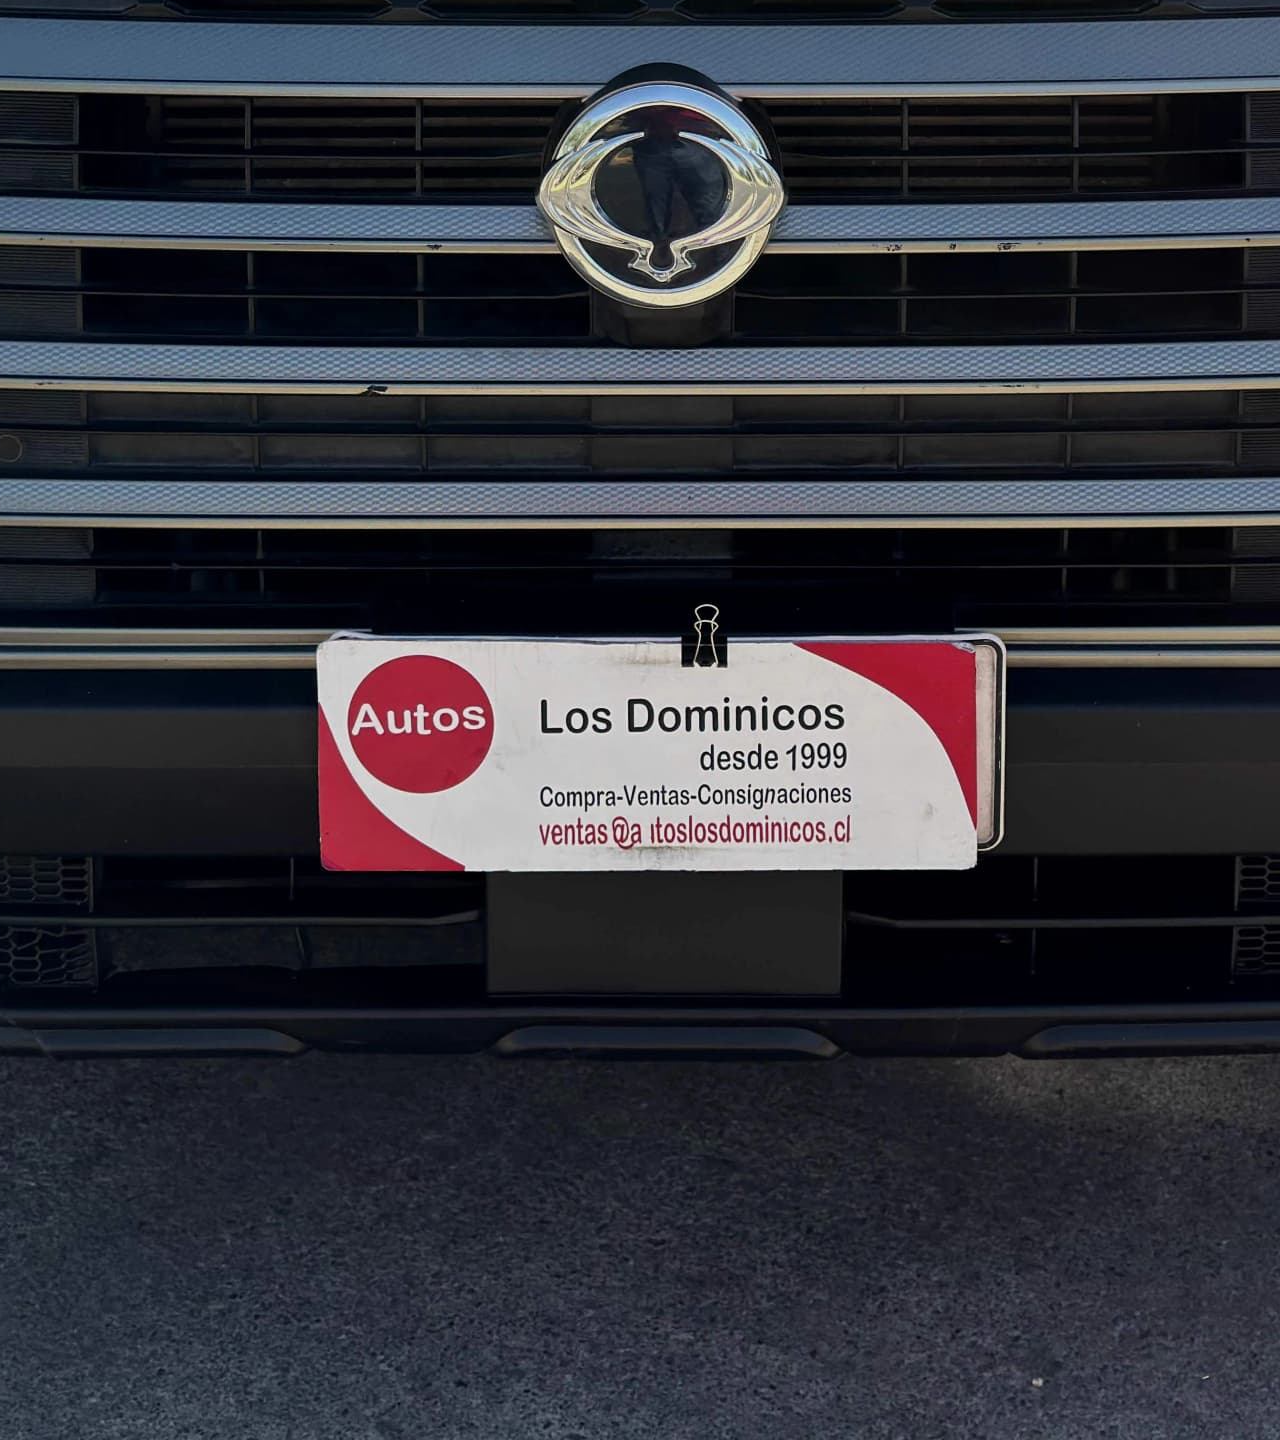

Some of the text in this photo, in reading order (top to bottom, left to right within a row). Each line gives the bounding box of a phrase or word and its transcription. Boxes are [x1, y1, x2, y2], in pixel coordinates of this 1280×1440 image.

[351, 702, 487, 736] Autos
[540, 696, 846, 735] Los Dominicos
[699, 741, 848, 771] desde 1999
[539, 782, 853, 812] Compra-Ventas-Consignaciones
